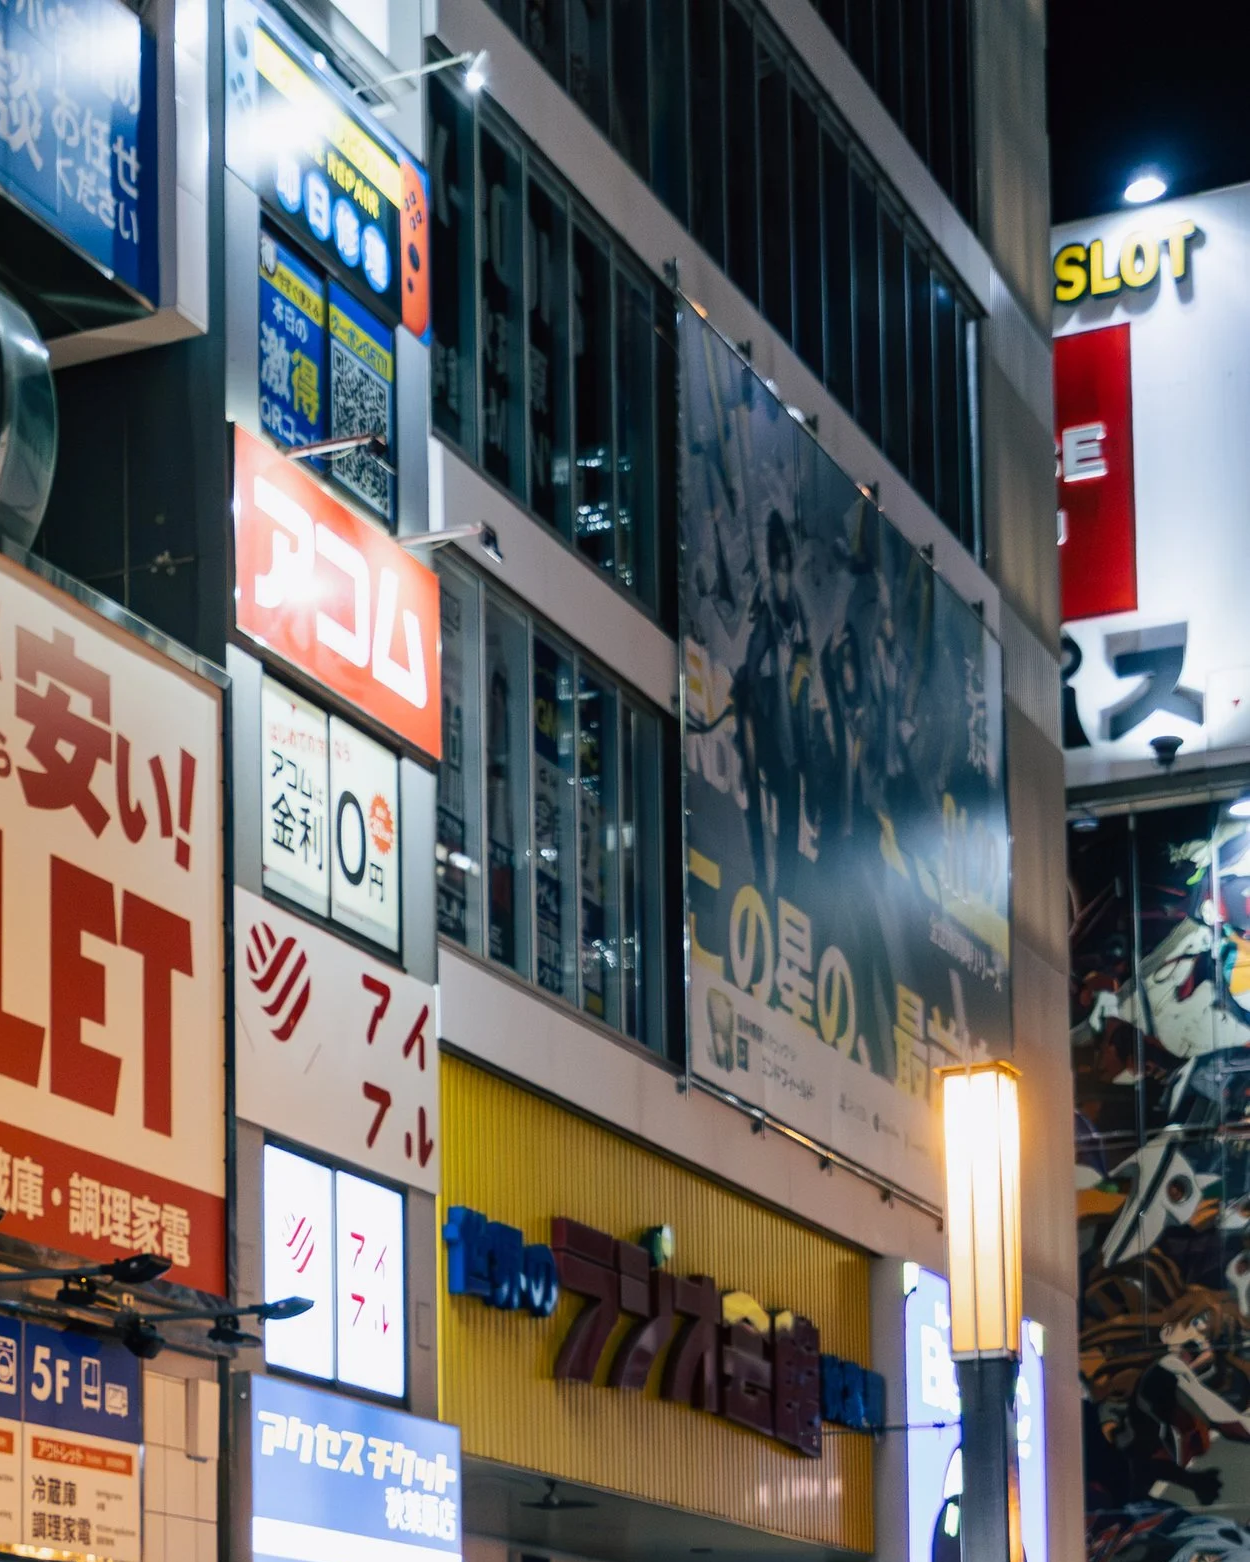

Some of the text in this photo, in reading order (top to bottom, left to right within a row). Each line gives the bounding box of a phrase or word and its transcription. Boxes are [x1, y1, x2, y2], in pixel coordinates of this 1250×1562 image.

[1053, 221, 1197, 302] SLOT
[271, 296, 309, 343] 本日の
[260, 320, 321, 425] 激得
[254, 475, 427, 710] アコム
[271, 793, 324, 871] 金利
[31, 1345, 70, 1405] 5F
[32, 1474, 77, 1508] 冷蔵庫
[32, 1511, 91, 1547] 調理家電
